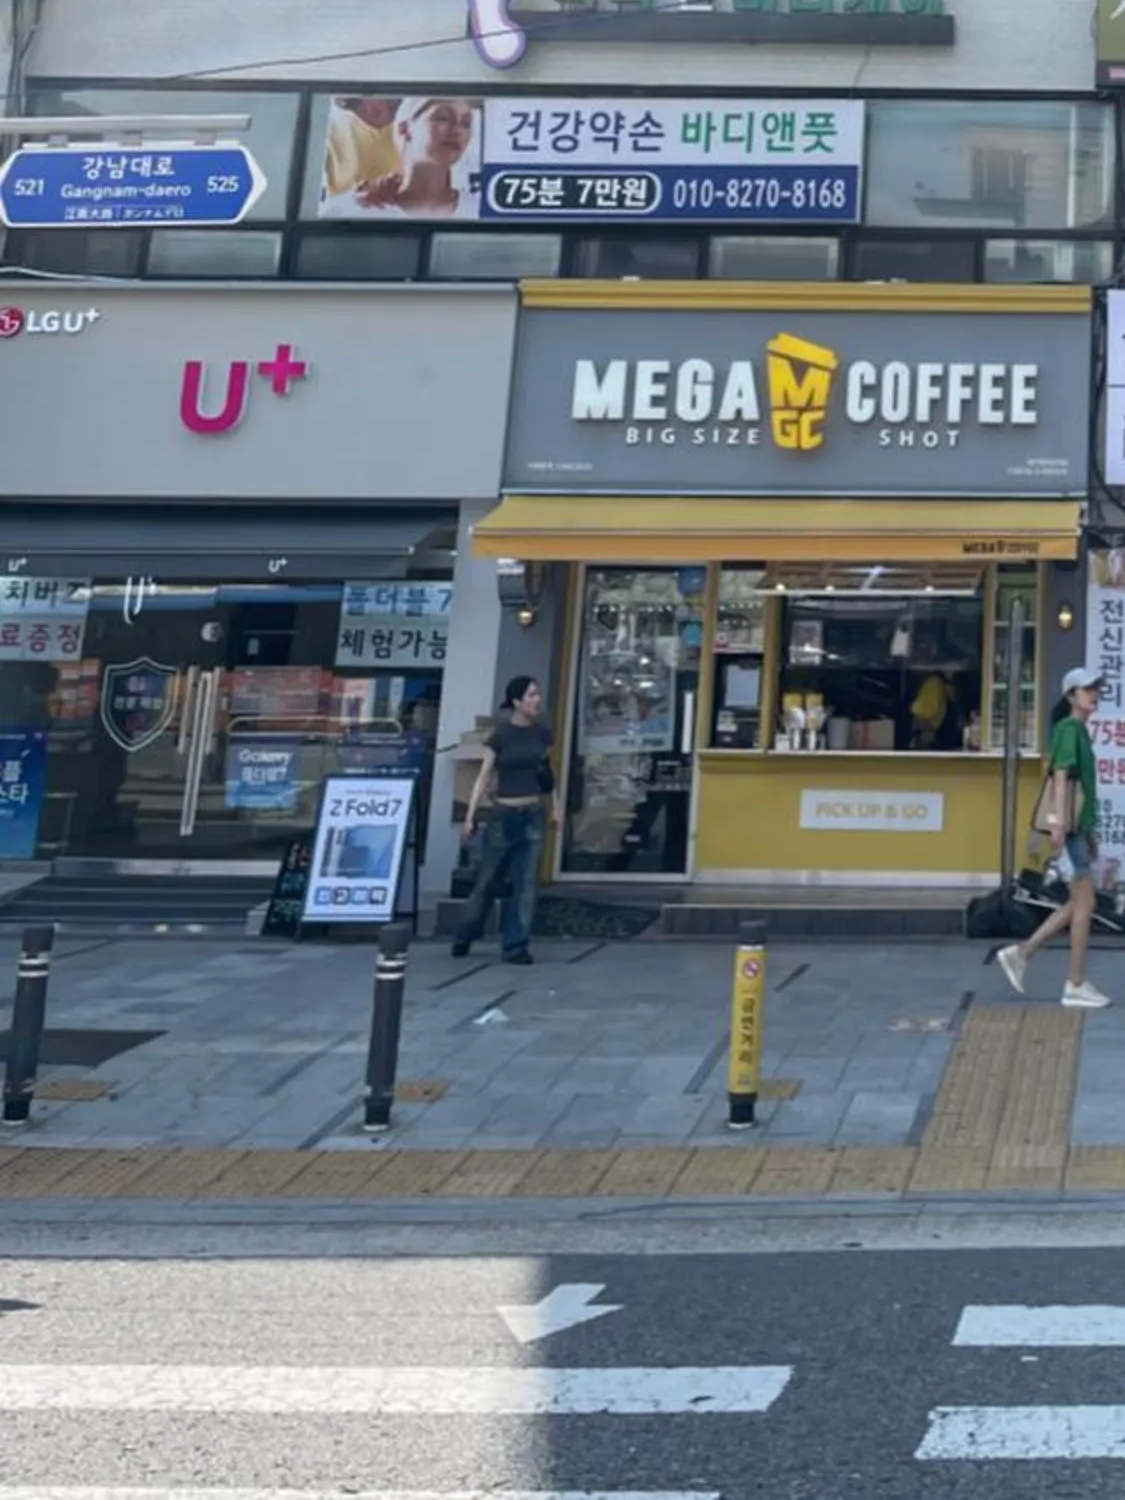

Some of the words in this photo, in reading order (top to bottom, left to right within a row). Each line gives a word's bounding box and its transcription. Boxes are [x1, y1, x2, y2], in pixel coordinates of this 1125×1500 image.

[507, 110, 666, 153] 건강약손
[680, 111, 838, 153] 바디앤풋
[82, 156, 176, 180] 강남대로
[14, 179, 44, 197] 521
[60, 182, 192, 202] Gangnam-daero
[207, 176, 239, 193] 525
[504, 179, 565, 206] 75분
[577, 178, 648, 207] 7만원
[673, 180, 846, 207] 010-8270-8168
[180, 344, 307, 434] U+
[571, 359, 760, 422] MEGA
[846, 361, 1038, 424] COFFEE
[626, 427, 676, 444] BIG
[693, 428, 760, 445] SIZE
[879, 430, 960, 448] SHOT
[341, 630, 448, 660] 체험가능
[329, 799, 343, 816] Z
